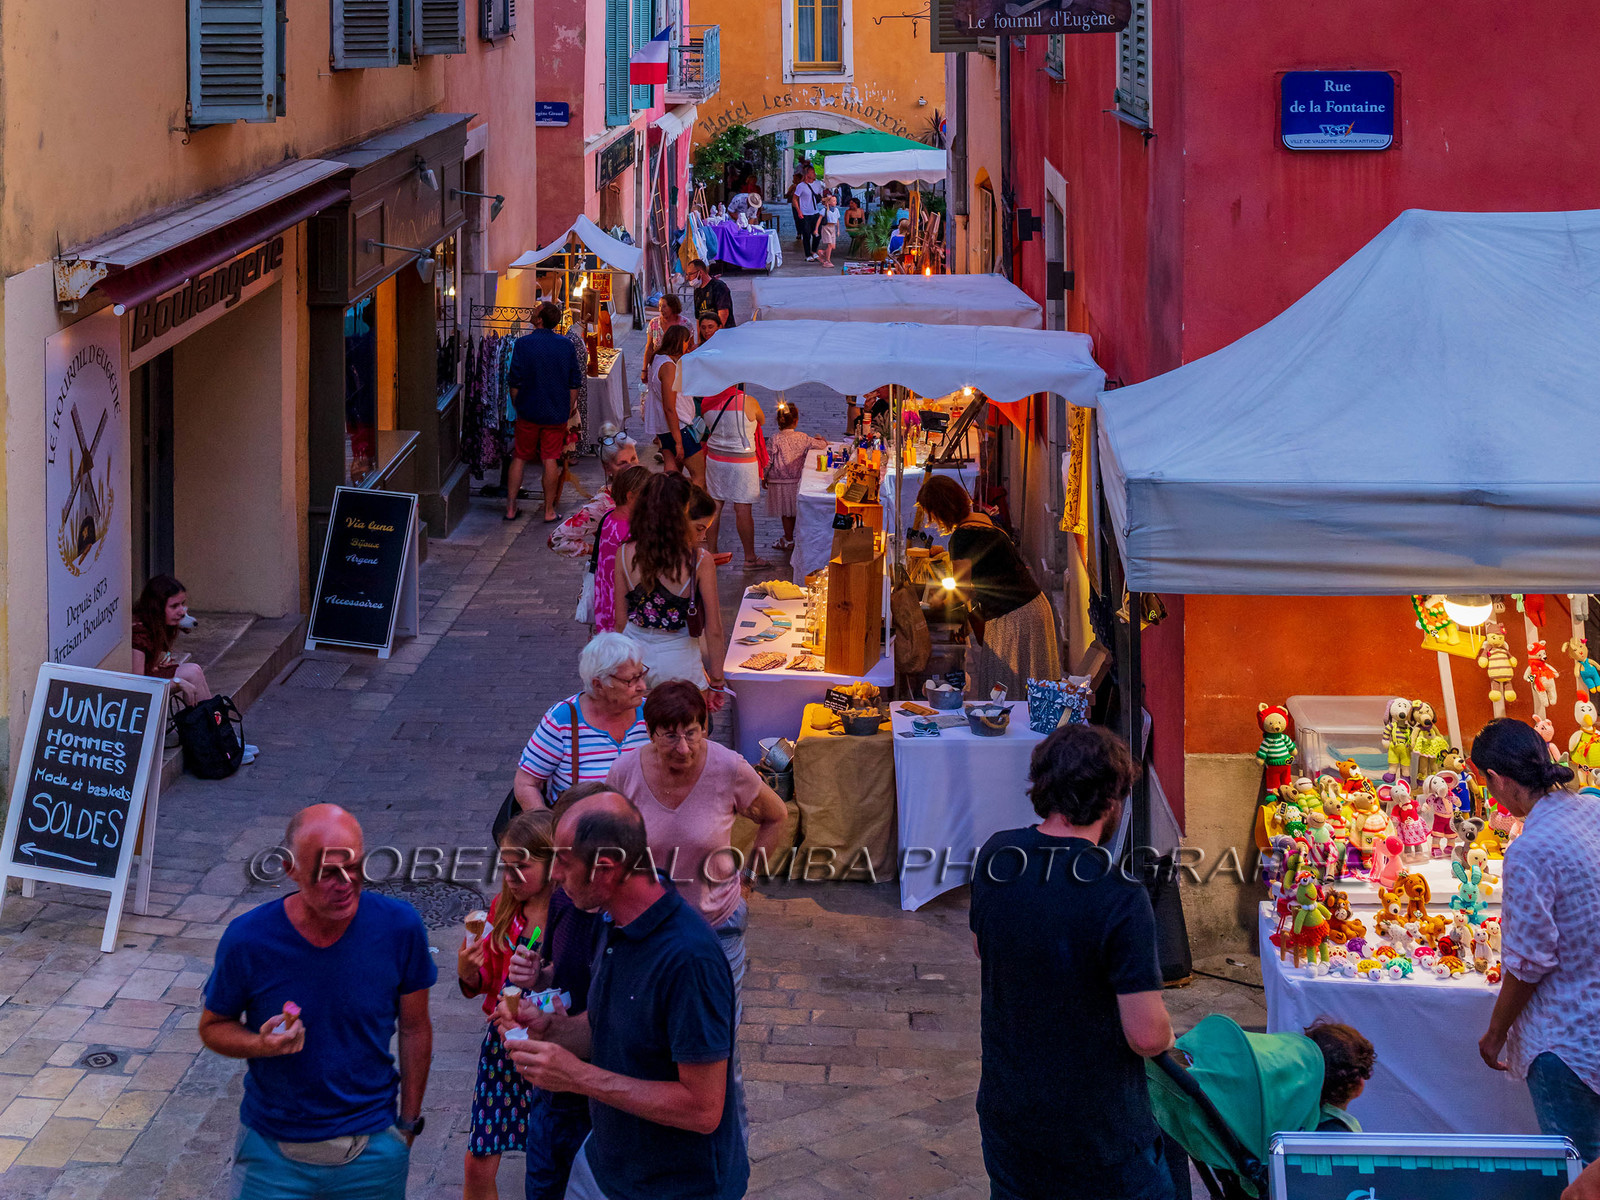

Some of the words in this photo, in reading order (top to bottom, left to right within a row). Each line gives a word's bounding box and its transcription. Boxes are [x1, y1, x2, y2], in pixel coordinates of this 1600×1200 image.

[968, 14, 986, 29] Le
[994, 12, 1042, 29] fournil
[1050, 10, 1116, 32] d'Eugène
[1324, 80, 1351, 92] Rue
[1289, 100, 1306, 113] de
[1309, 100, 1322, 113] la
[1325, 100, 1386, 113] Fontaine
[131, 236, 284, 352] Boulangerie
[52, 347, 88, 430] FOURNIL
[345, 517, 365, 530] Via
[350, 538, 380, 550] Bijoux
[345, 554, 379, 566] Argent
[65, 593, 92, 628] Depuis
[93, 577, 108, 603] 1873
[324, 594, 385, 610] Accessoires
[54, 631, 82, 664] Artisan
[83, 597, 120, 640] Boulanger
[49, 687, 145, 735] JUNGLE
[47, 728, 126, 758] HOMMES
[43, 745, 127, 775] FEMMES
[34, 768, 70, 786] Mode
[71, 781, 83, 792] et
[87, 780, 131, 802] baskets
[28, 792, 124, 848] SOLDES
